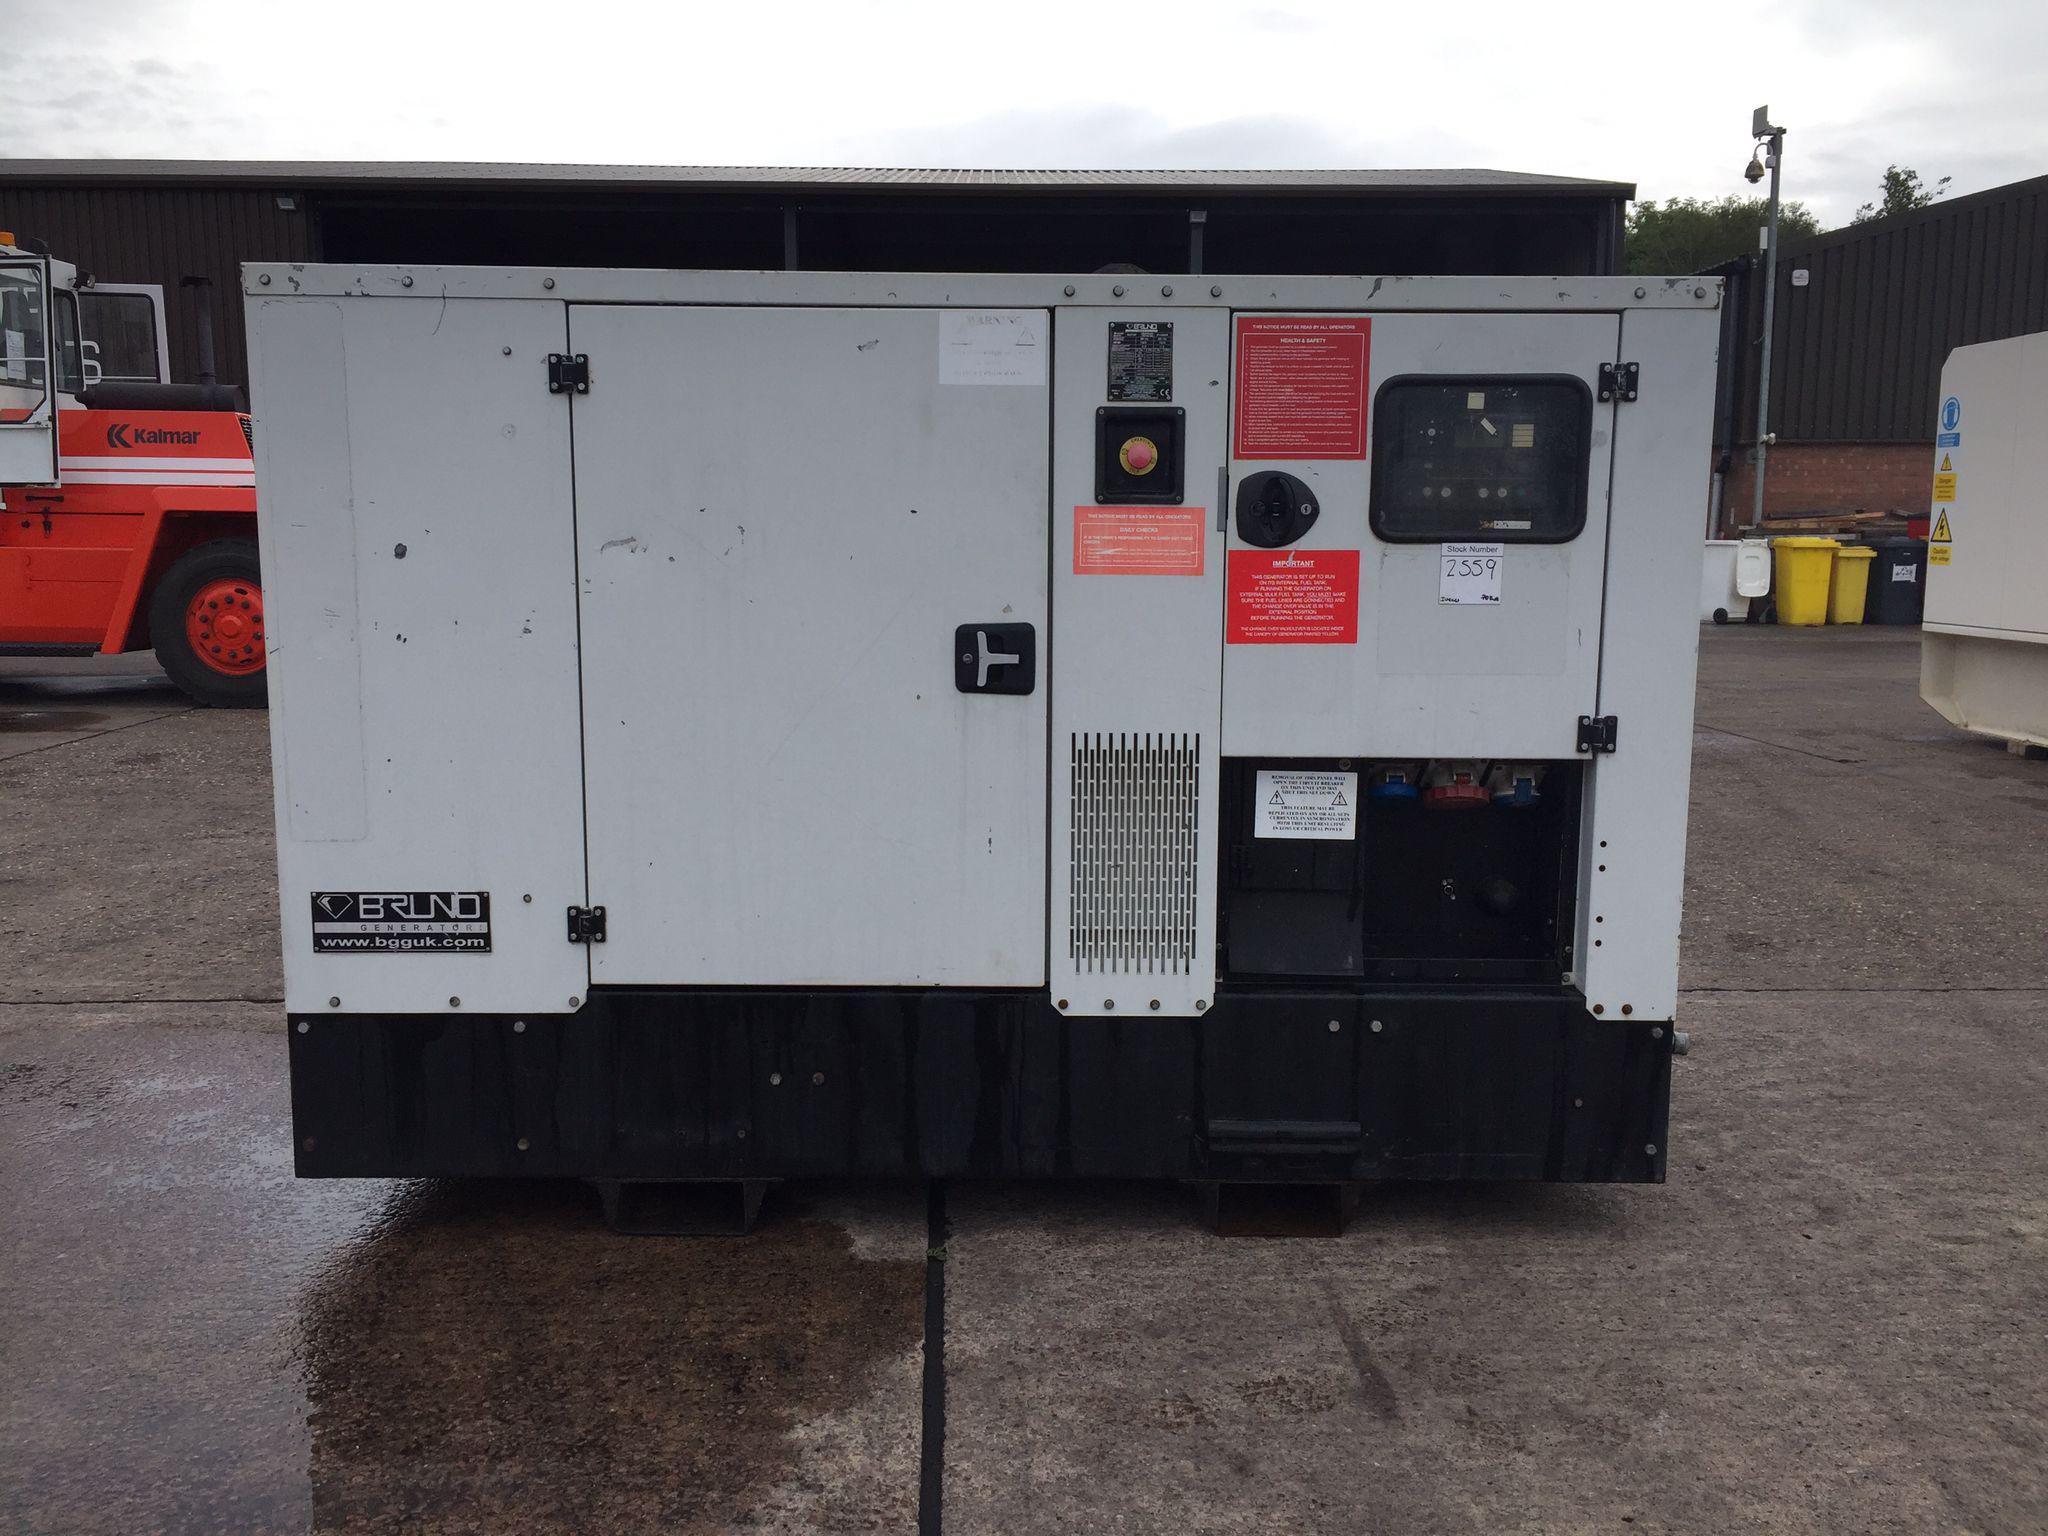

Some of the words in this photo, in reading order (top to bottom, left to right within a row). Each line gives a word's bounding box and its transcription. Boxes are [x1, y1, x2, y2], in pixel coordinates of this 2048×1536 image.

[134, 428, 201, 444] Kalmar
[1447, 545, 1468, 553] Stock
[1469, 545, 1499, 553] Number
[1446, 558, 1497, 580] 2559
[358, 894, 481, 919] BRUNO
[321, 936, 485, 949] www.bgguk.com
